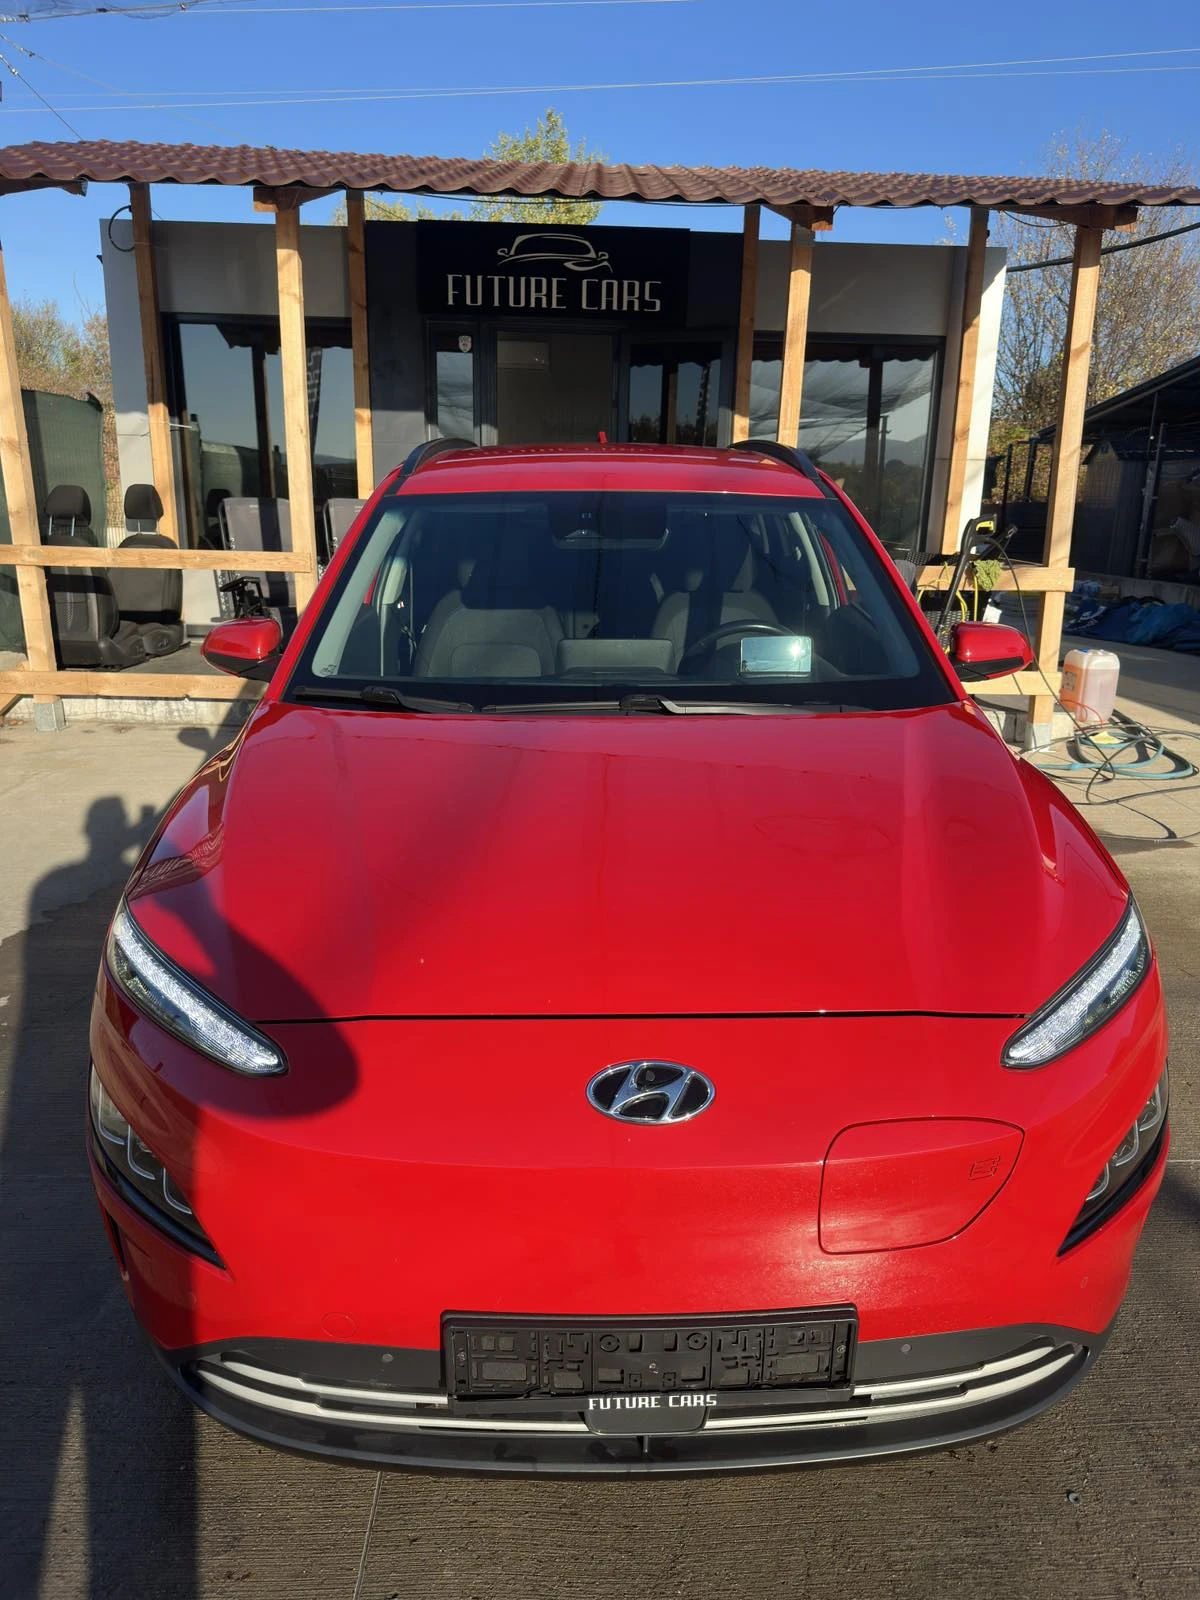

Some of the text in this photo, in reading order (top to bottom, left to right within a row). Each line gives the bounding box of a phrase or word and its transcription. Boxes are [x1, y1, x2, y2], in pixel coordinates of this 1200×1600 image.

[447, 274, 662, 312] FUTURE CARS
[588, 1394, 717, 1410] FUTURE CARS
